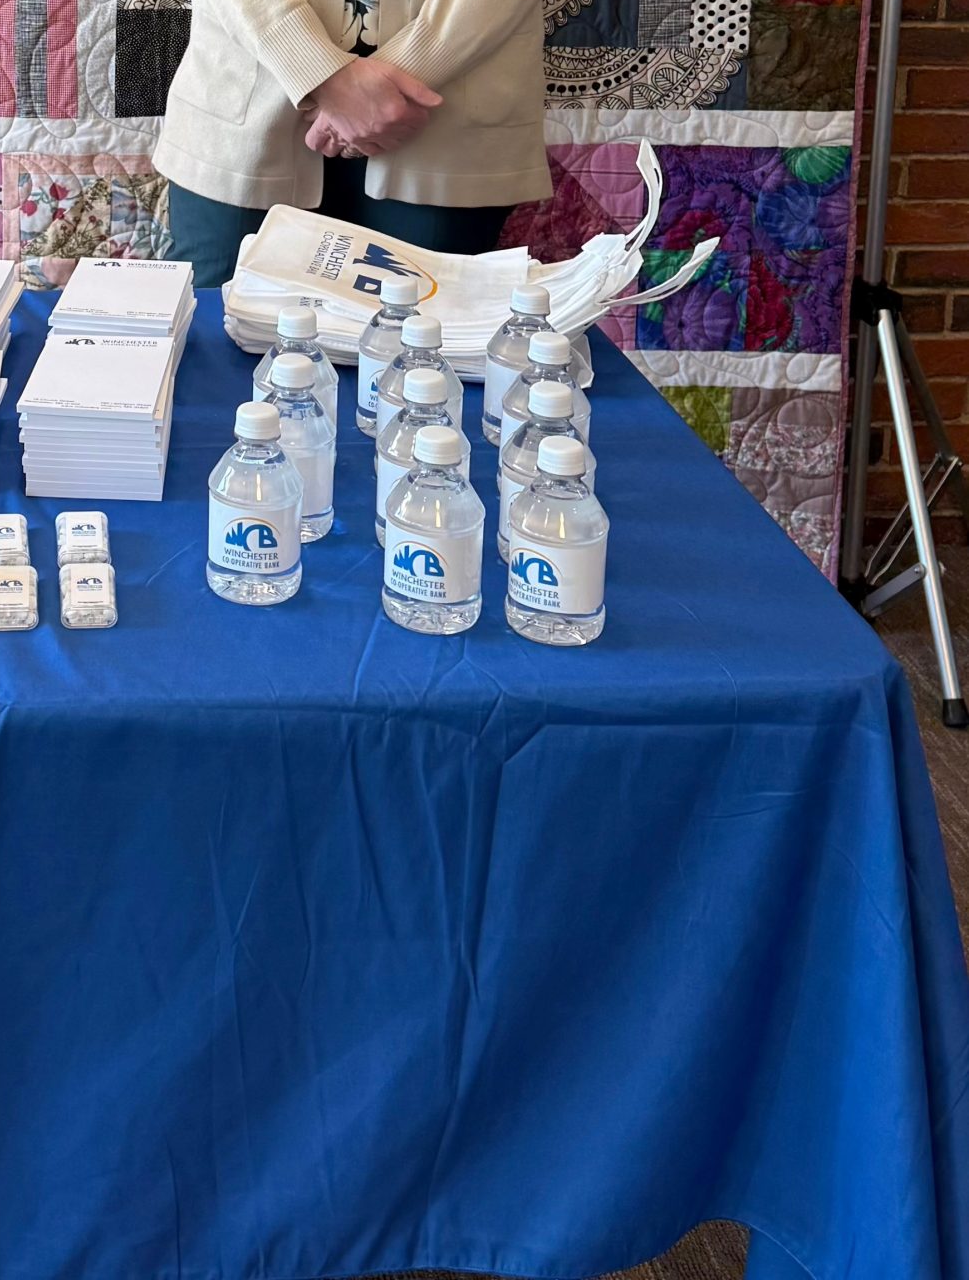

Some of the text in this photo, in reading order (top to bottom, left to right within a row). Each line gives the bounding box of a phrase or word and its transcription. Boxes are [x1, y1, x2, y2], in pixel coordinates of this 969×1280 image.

[223, 547, 279, 561] WINCHESTER
[264, 561, 280, 569] BANK
[391, 568, 446, 590] WINCHESTER
[430, 590, 447, 598] BANK
[543, 598, 561, 608] BANK
